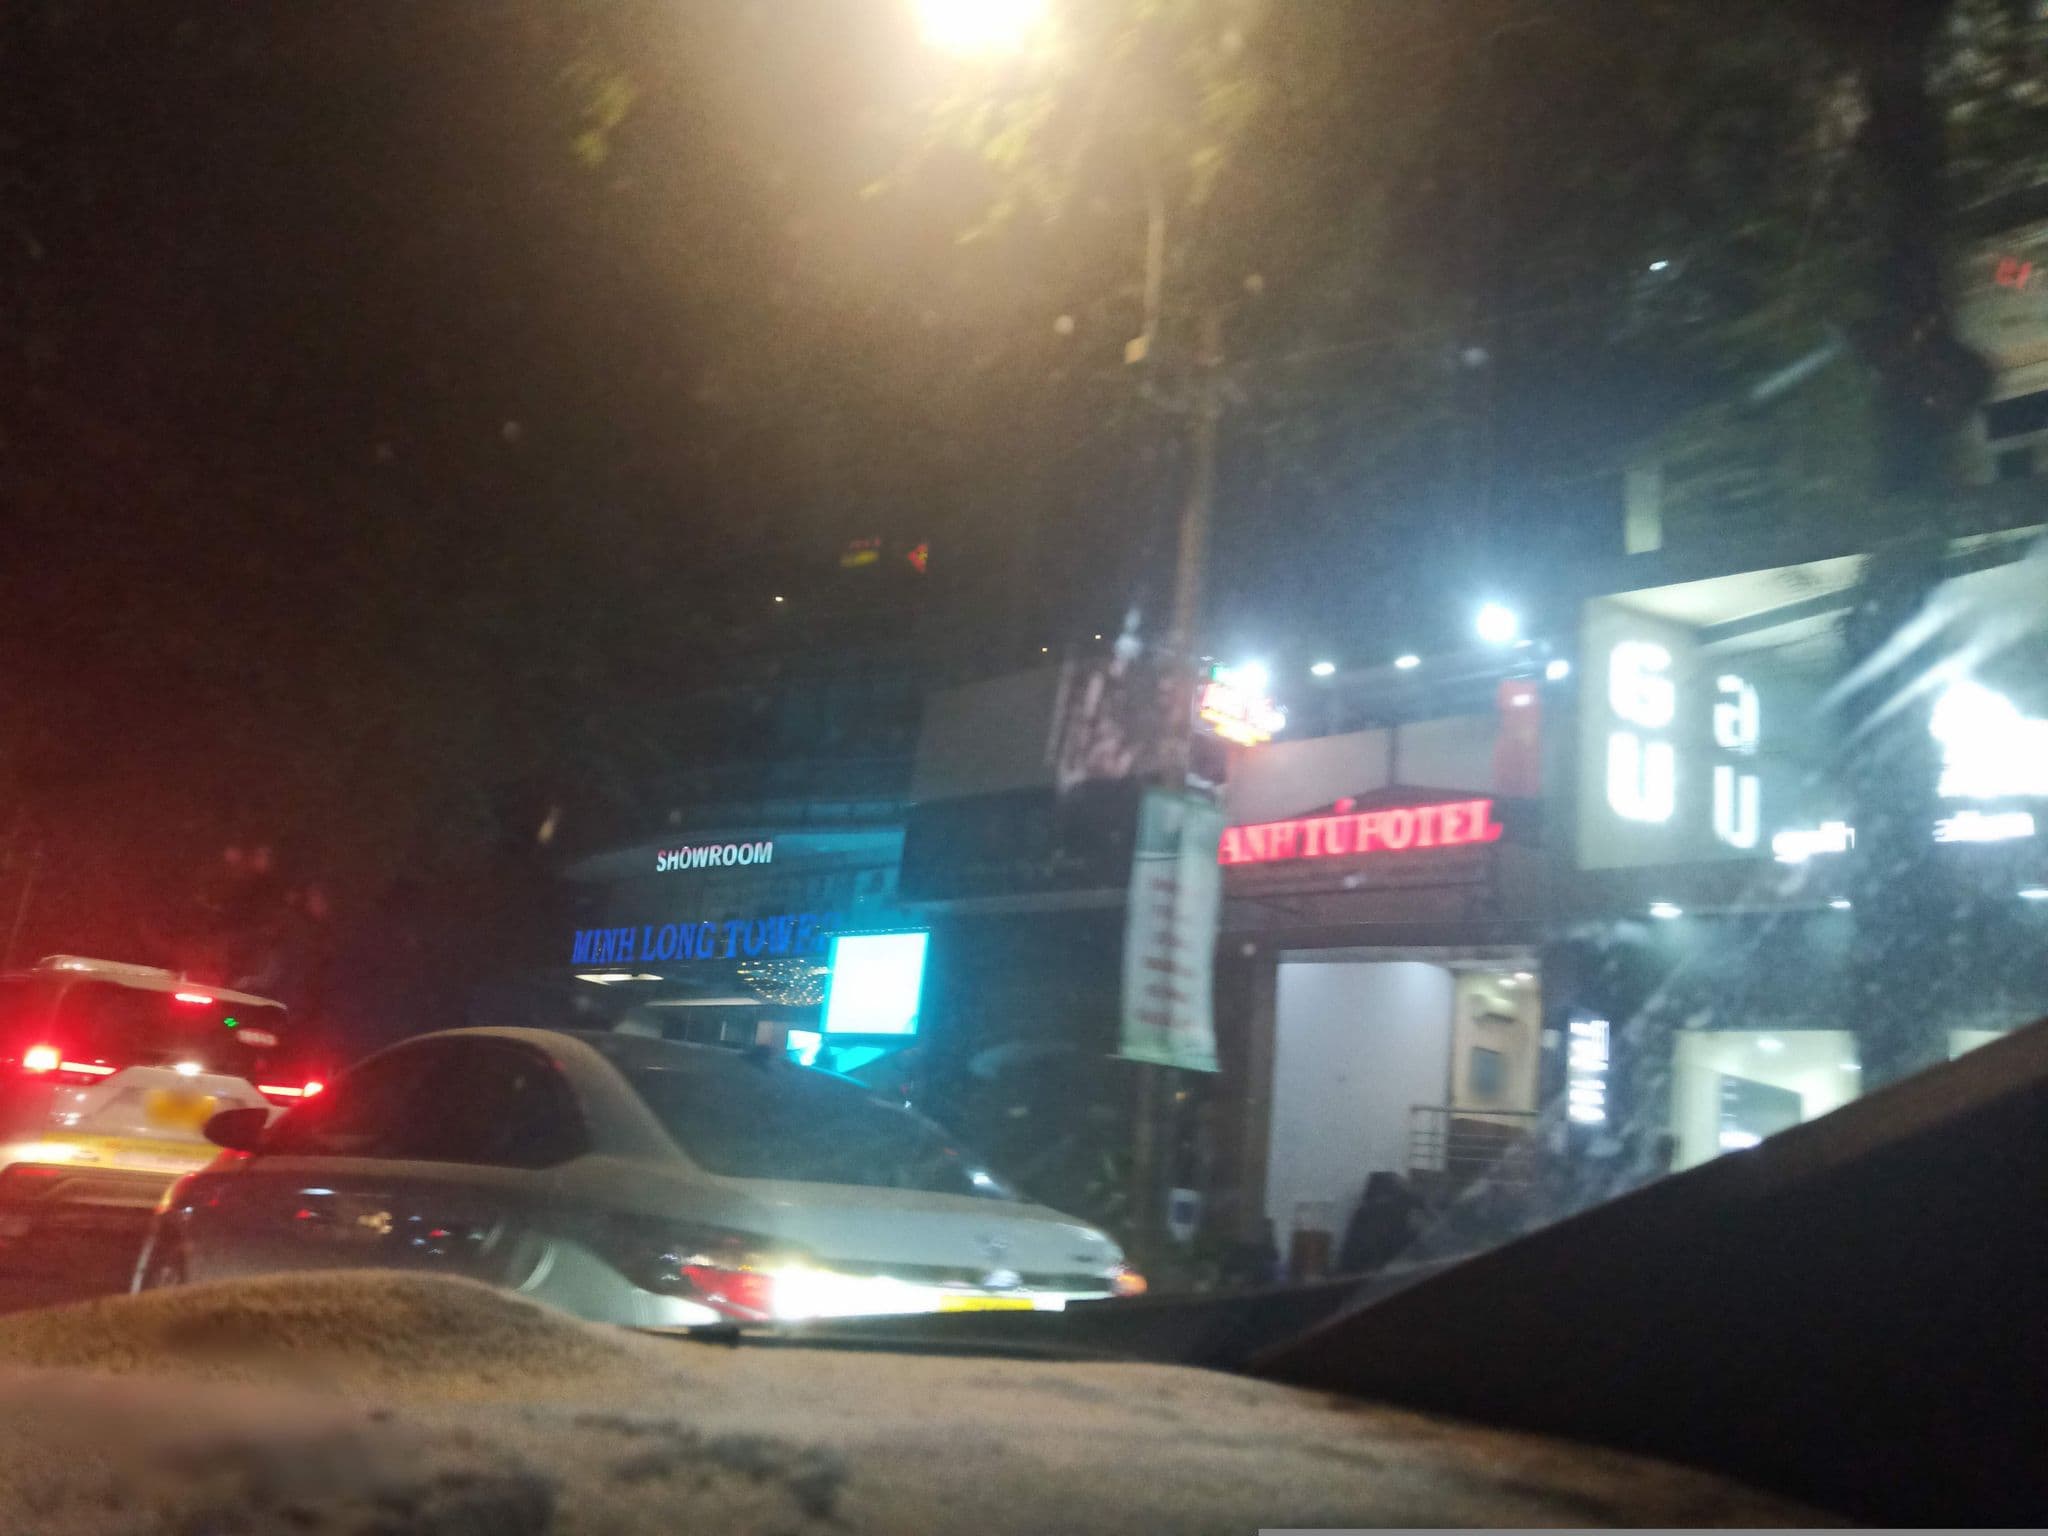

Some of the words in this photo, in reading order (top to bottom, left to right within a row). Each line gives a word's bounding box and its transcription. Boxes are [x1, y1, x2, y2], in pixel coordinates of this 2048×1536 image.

[1356, 799, 1504, 852] HOTEL
[656, 841, 774, 872] SHOWROOM
[571, 926, 637, 966] MINH
[640, 920, 716, 962] LONG
